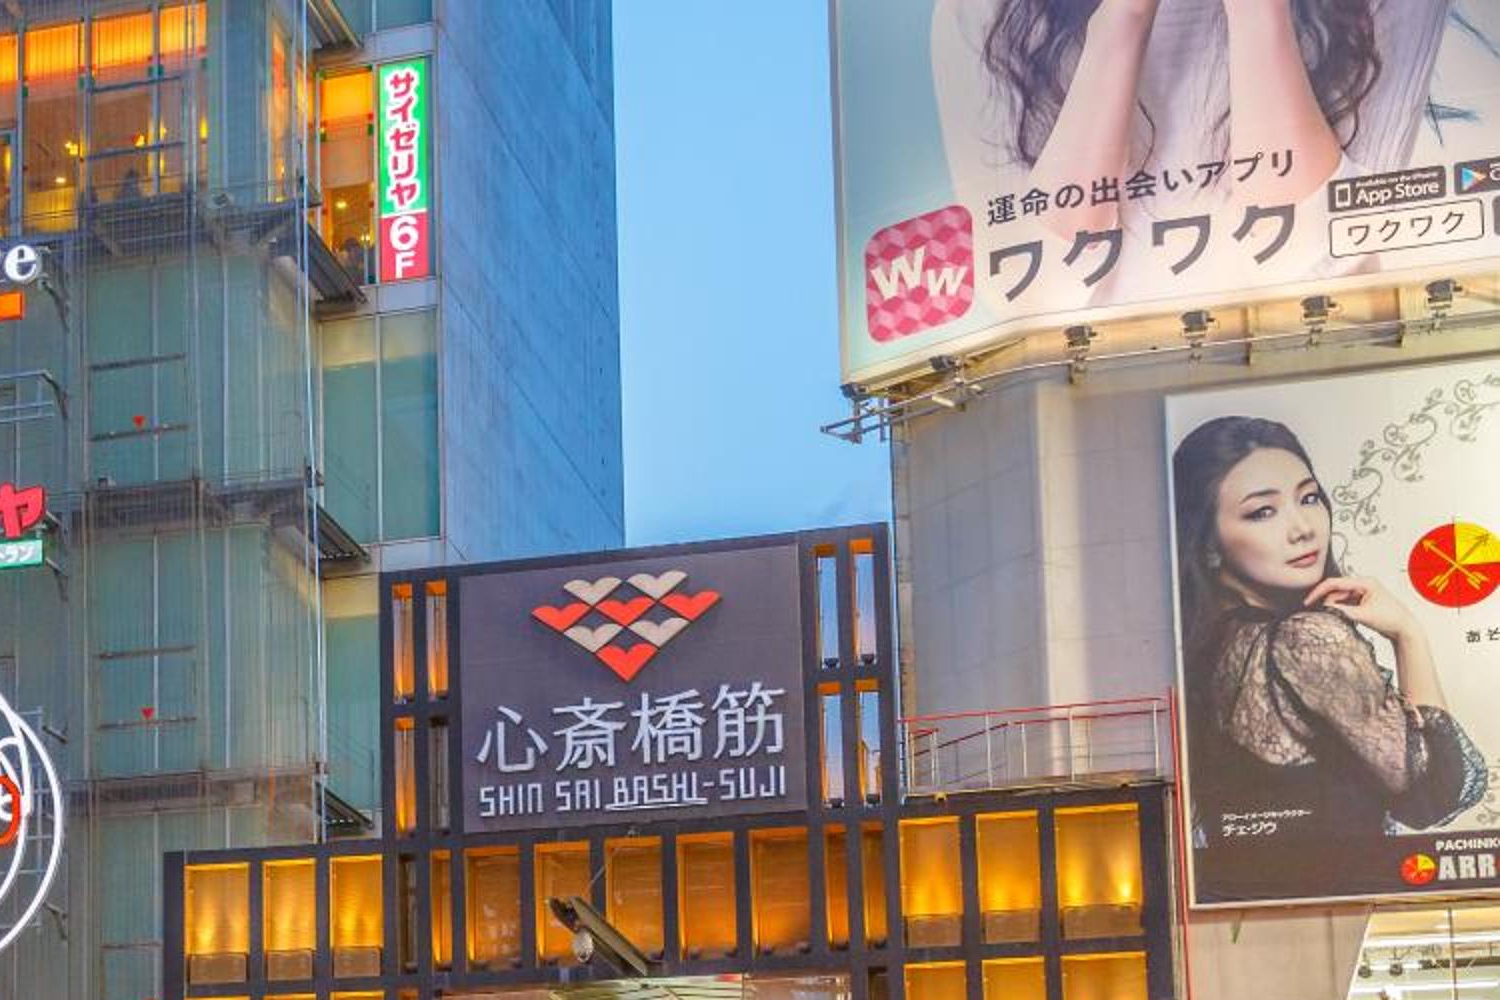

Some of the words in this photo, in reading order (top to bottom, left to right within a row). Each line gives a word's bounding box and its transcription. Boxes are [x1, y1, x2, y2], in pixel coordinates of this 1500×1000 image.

[389, 70, 418, 206] サイゼリヤ
[987, 148, 1296, 227] 運命の出会いアプリ
[1355, 188, 1392, 207] App
[1395, 181, 1440, 199] Store
[388, 215, 419, 279] 6F
[989, 203, 1297, 302] ワクワク
[1348, 211, 1465, 246] ワクワク
[476, 682, 787, 774] 心斎橋筋
[479, 782, 544, 817] SHIN
[556, 778, 601, 811] SAI
[605, 765, 787, 811] BASHI-SUJI
[1436, 836, 1500, 851] PACHINK
[1438, 854, 1500, 881] ARR
